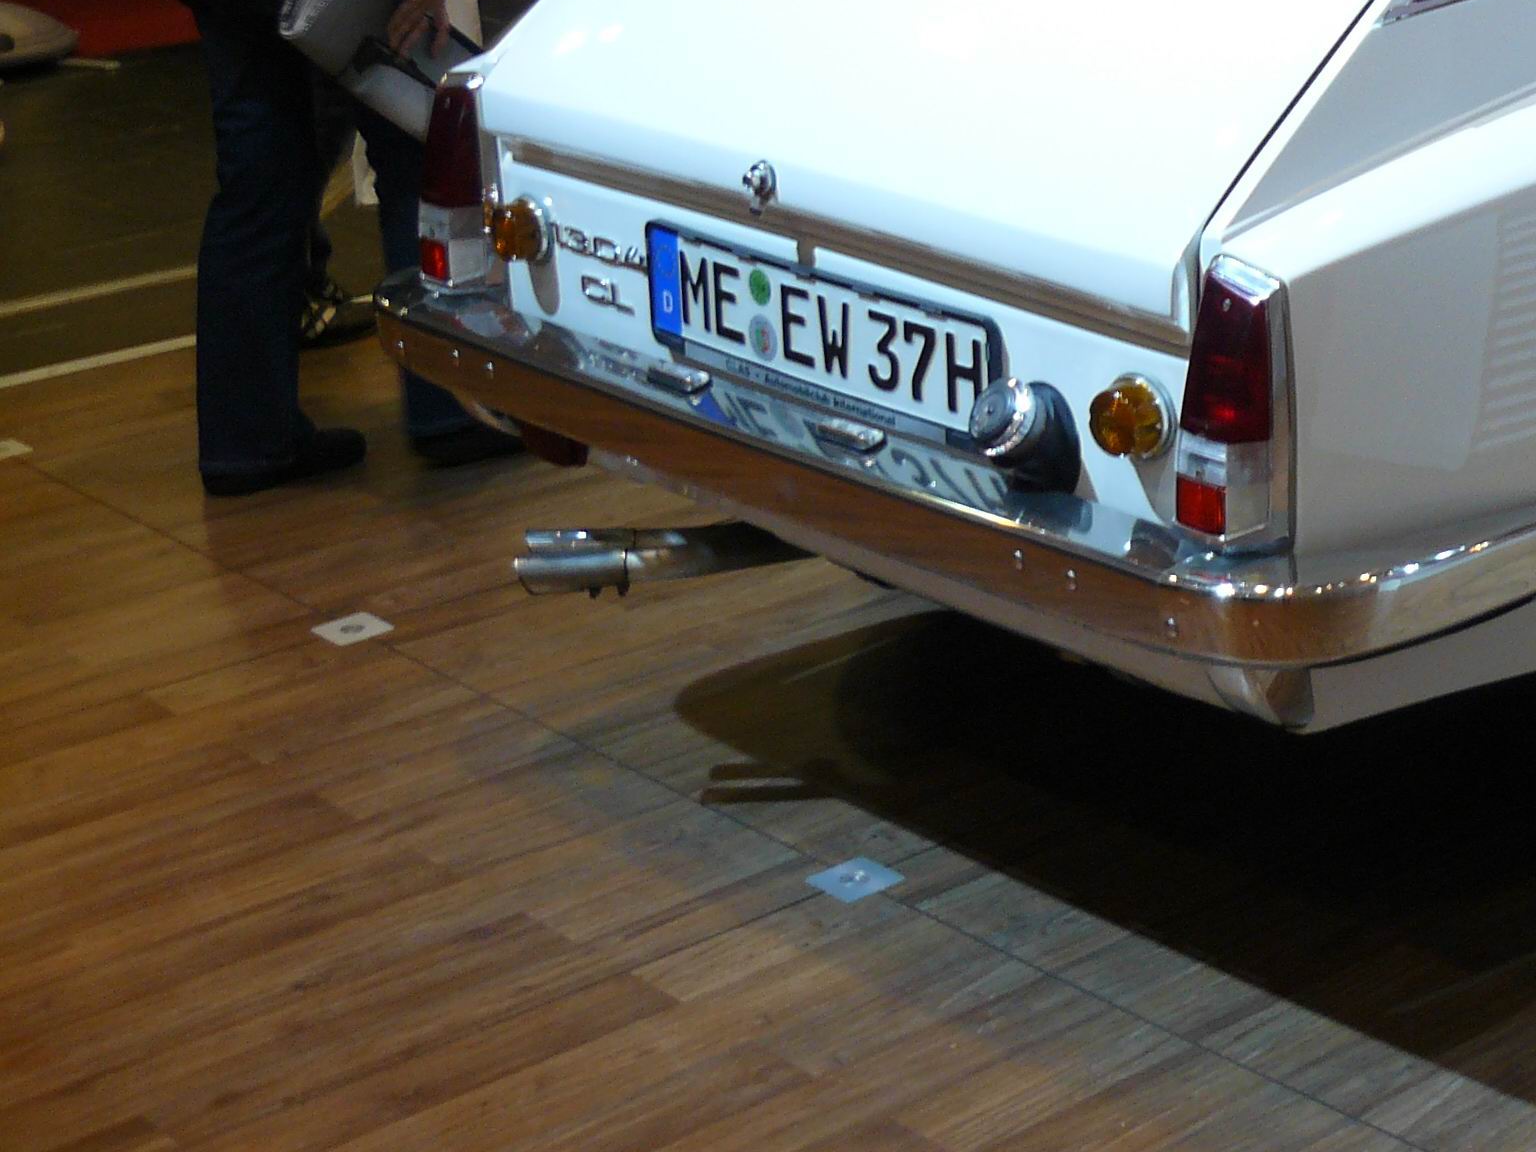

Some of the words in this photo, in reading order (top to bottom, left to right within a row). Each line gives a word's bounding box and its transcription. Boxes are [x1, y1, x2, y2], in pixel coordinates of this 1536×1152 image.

[581, 274, 636, 317] CL
[662, 290, 674, 314] D
[679, 250, 746, 345] ME
[780, 284, 850, 379] EW
[867, 308, 984, 414] 37H
[833, 395, 897, 426] International
